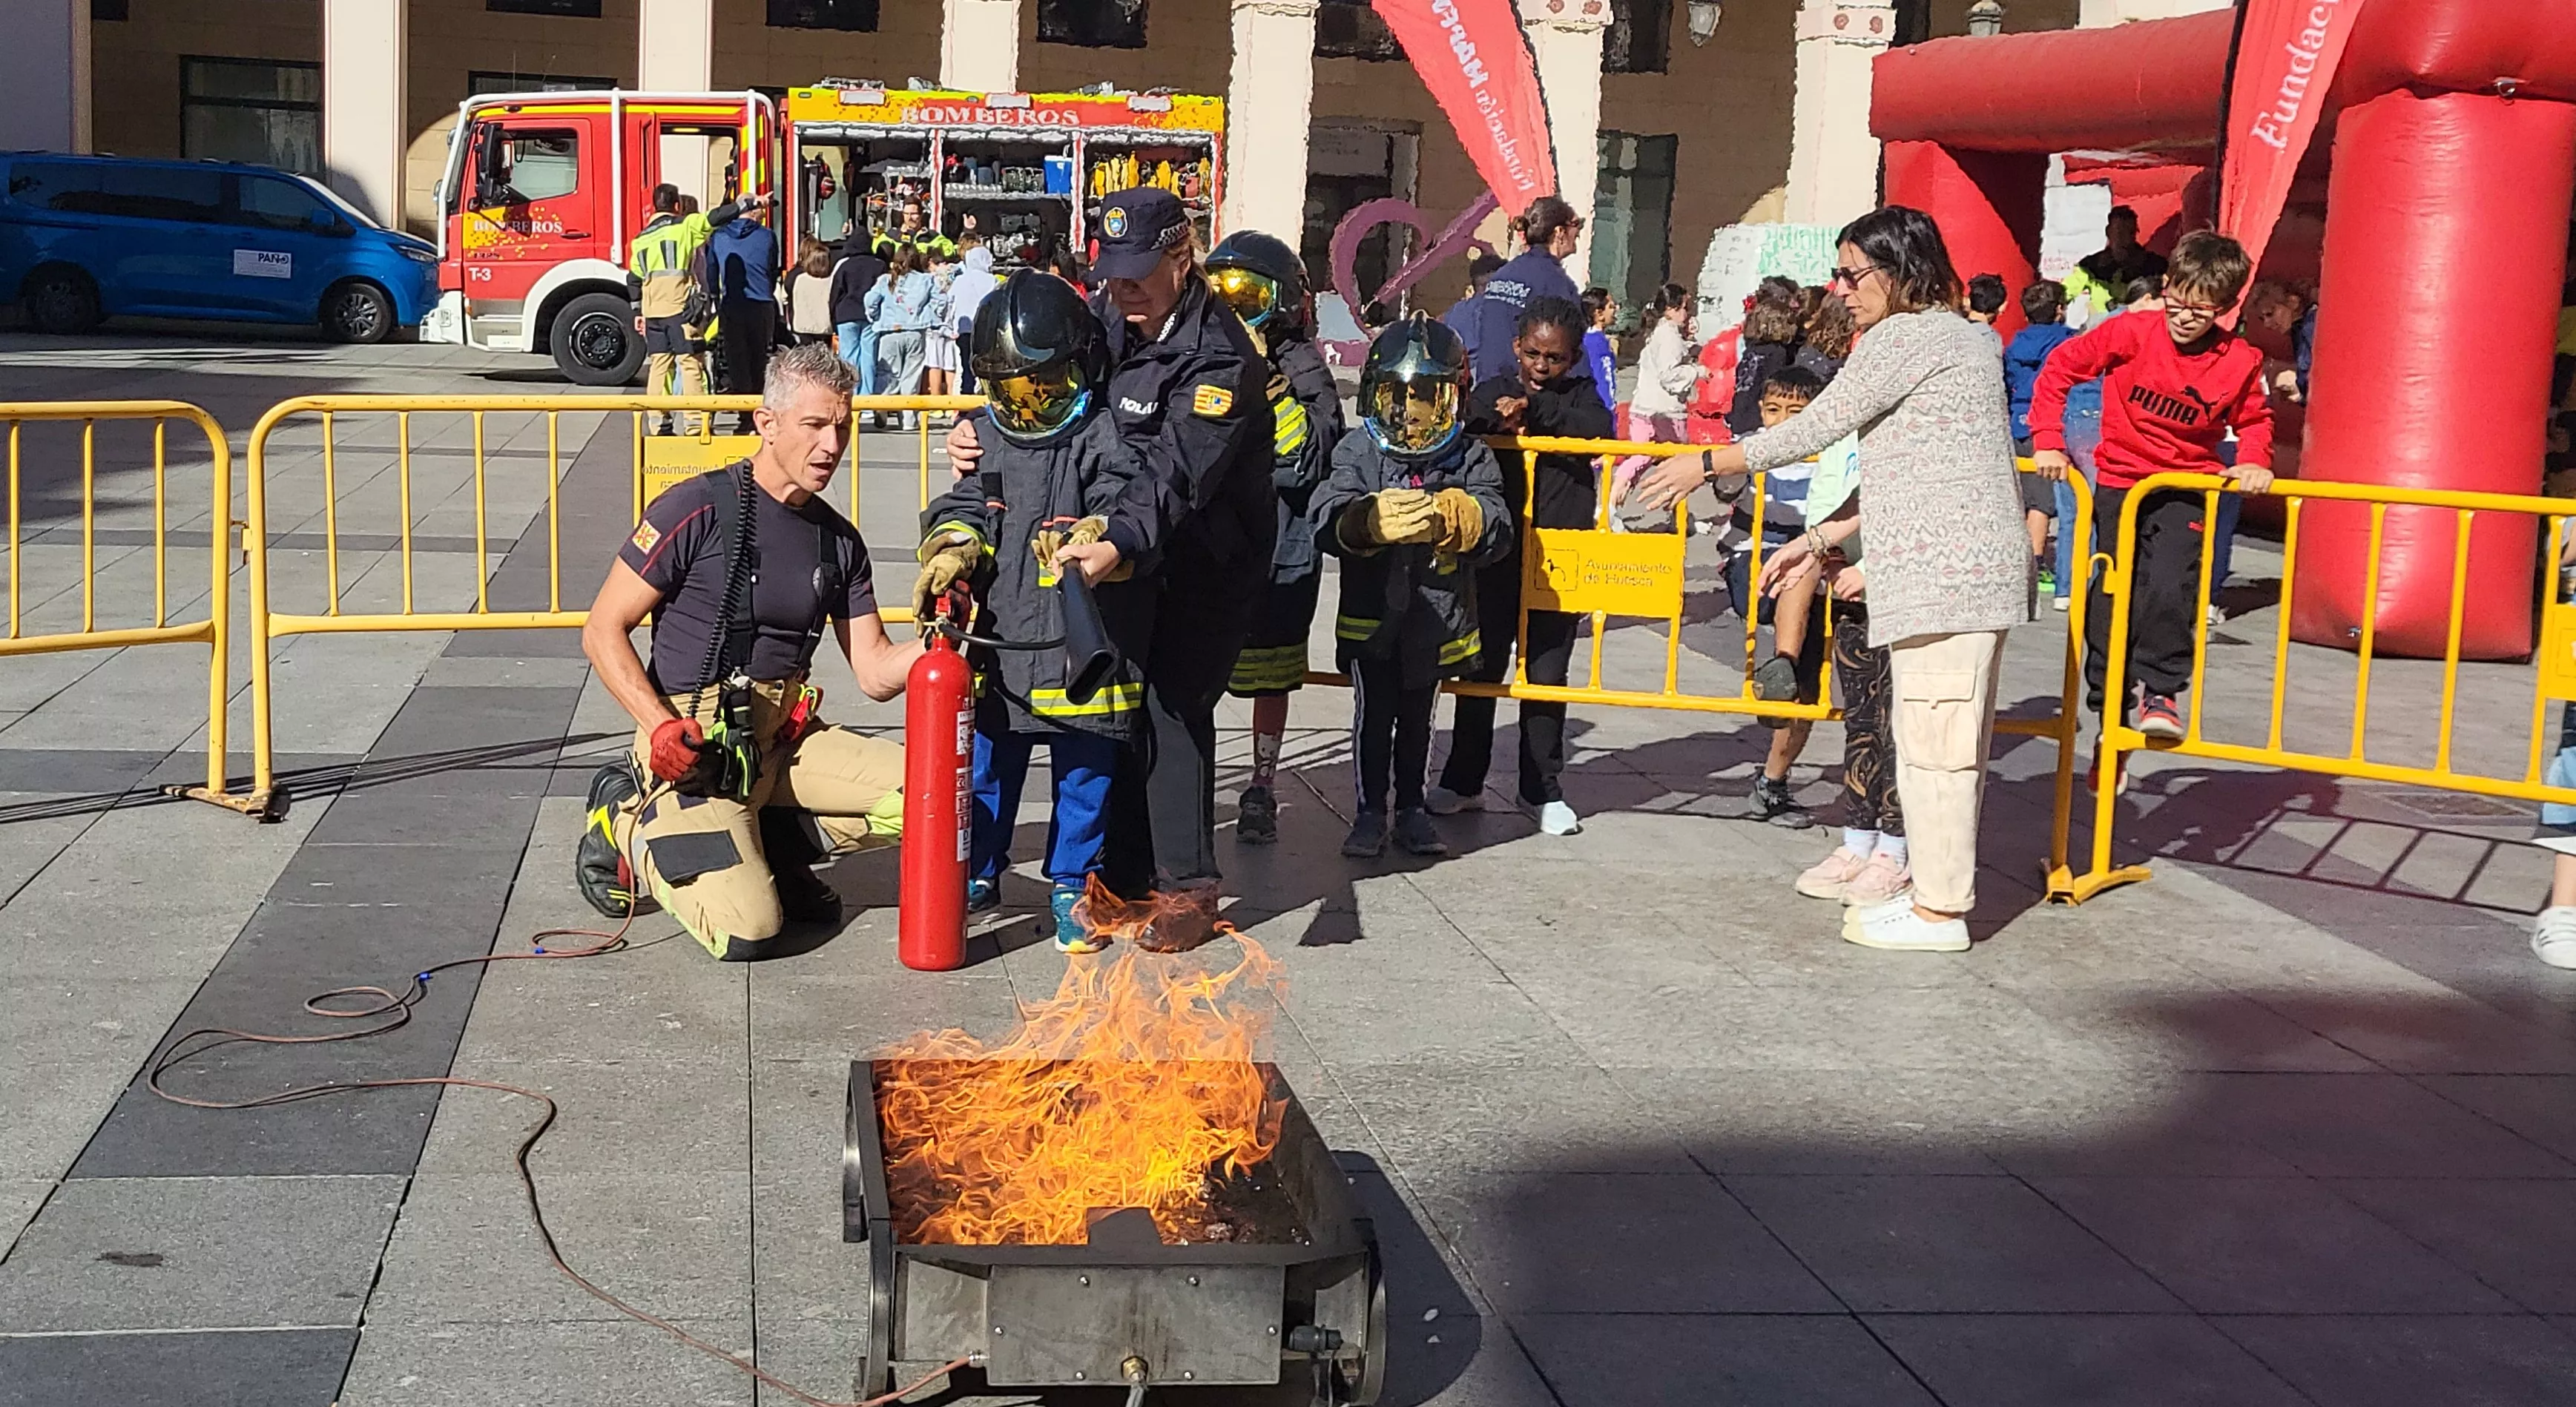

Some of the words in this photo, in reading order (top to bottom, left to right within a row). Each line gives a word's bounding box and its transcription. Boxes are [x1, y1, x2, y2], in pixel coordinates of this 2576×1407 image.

[2250, 0, 2337, 148] Fundac
[900, 106, 1081, 125] BOMBEROS
[469, 267, 492, 281] T-3
[2127, 384, 2200, 425] PUMA
[1586, 559, 1672, 574] Ayuntamiento
[1584, 573, 1600, 585] de
[1605, 574, 1653, 587] Huesca
